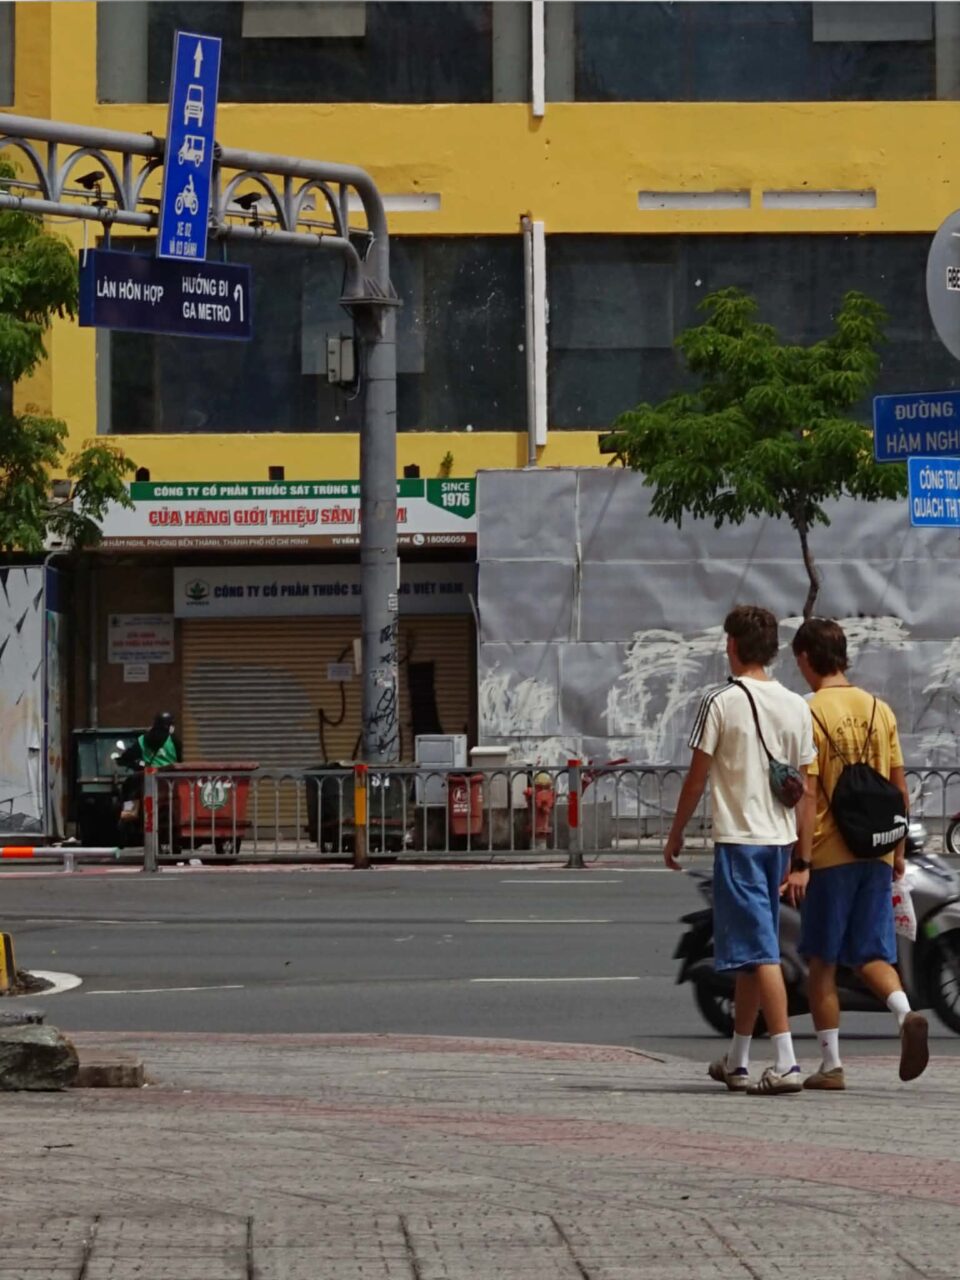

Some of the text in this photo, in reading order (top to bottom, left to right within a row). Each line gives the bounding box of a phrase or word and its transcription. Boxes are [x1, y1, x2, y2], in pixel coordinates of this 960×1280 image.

[182, 273, 229, 298] HƯỚNG ĐI
[182, 301, 231, 323] GA METRO
[894, 400, 954, 420] ĐƯỜNG
[886, 427, 921, 454] HÀM
[441, 482, 470, 492] SINCE
[919, 465, 944, 490] CÔNG
[154, 485, 183, 497] CÔNG
[186, 486, 200, 497] TY
[441, 492, 470, 507] 1976
[914, 492, 944, 518] QUÁCH
[246, 586, 261, 597] TY
[872, 825, 905, 847] PUMA
